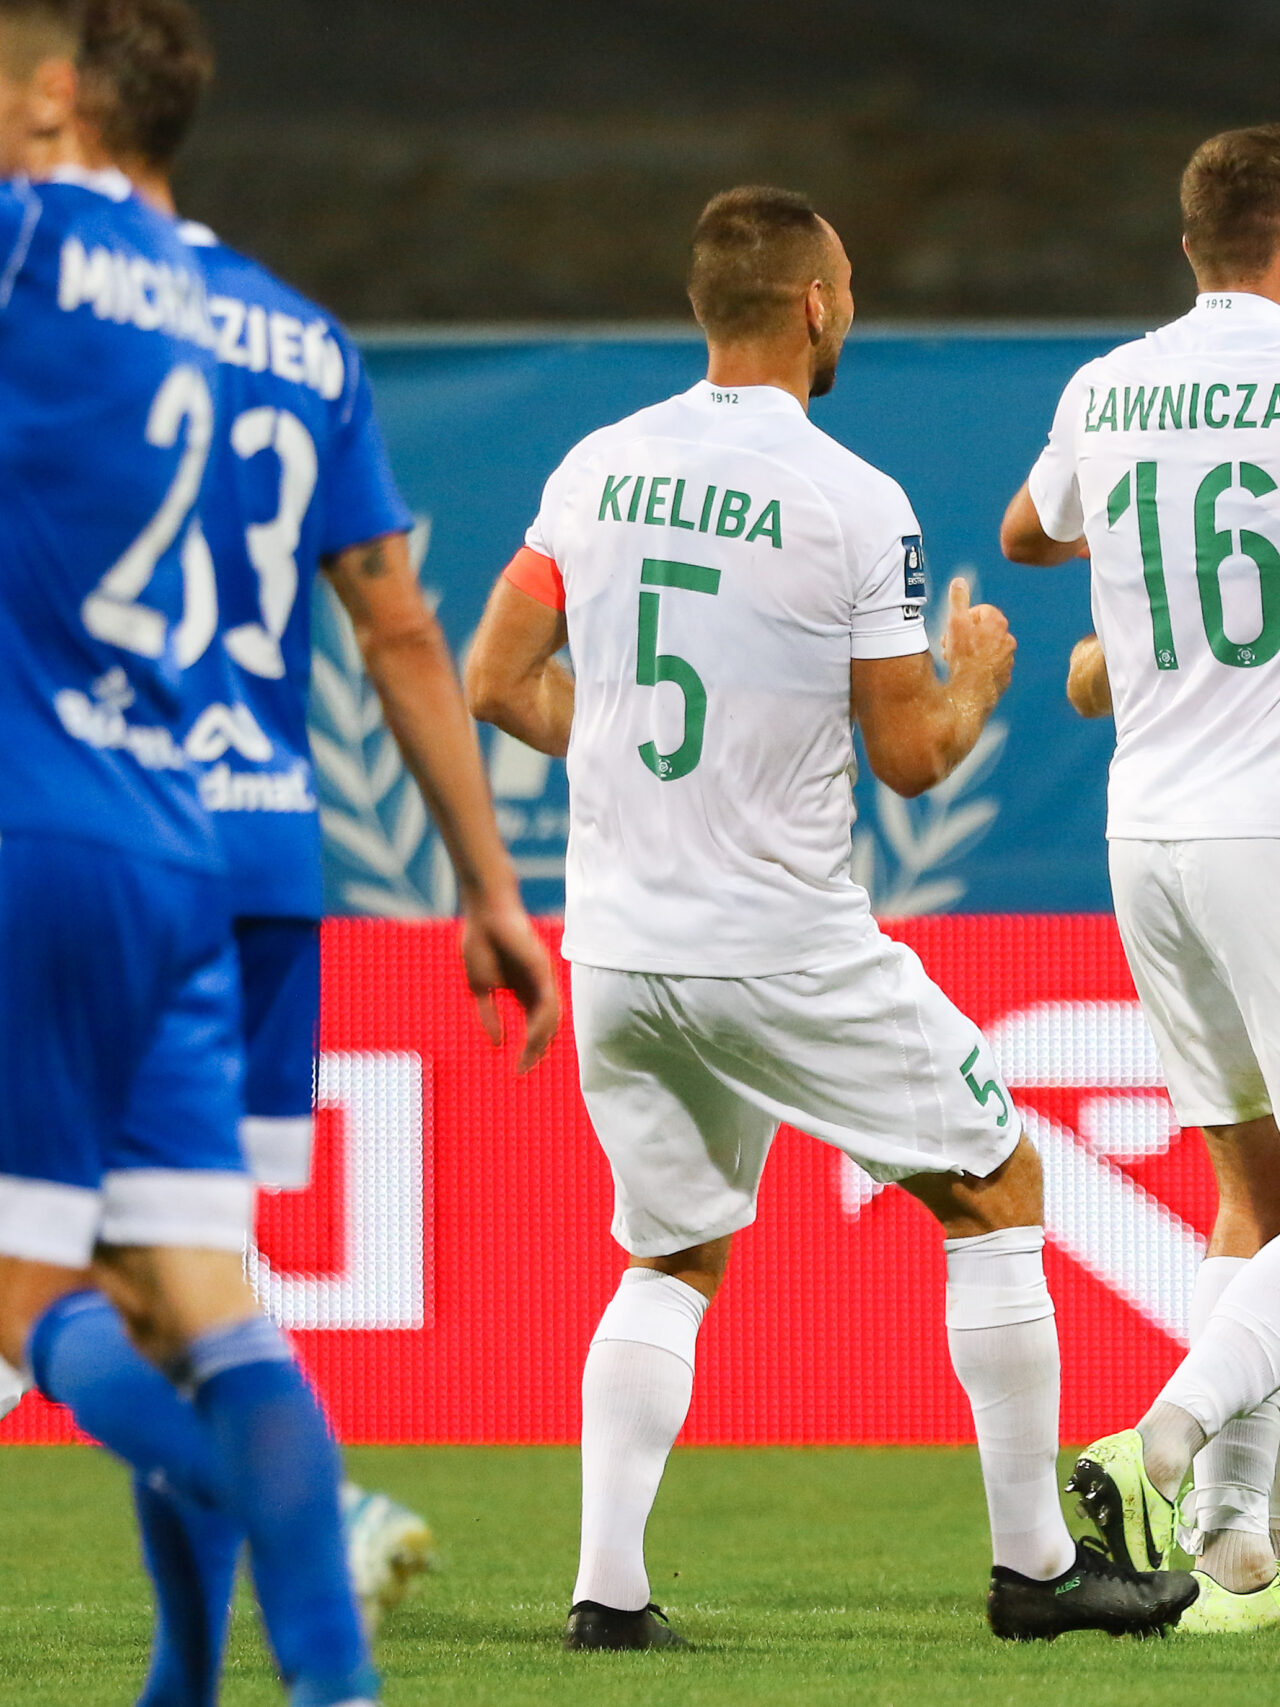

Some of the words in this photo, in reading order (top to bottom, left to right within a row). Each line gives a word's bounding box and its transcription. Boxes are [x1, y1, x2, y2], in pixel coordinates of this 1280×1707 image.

[1206, 298, 1232, 309] 1912
[711, 391, 739, 404] 1912
[598, 475, 783, 549] KIELIBA
[637, 558, 721, 781] 5
[959, 1044, 1008, 1127] 5
